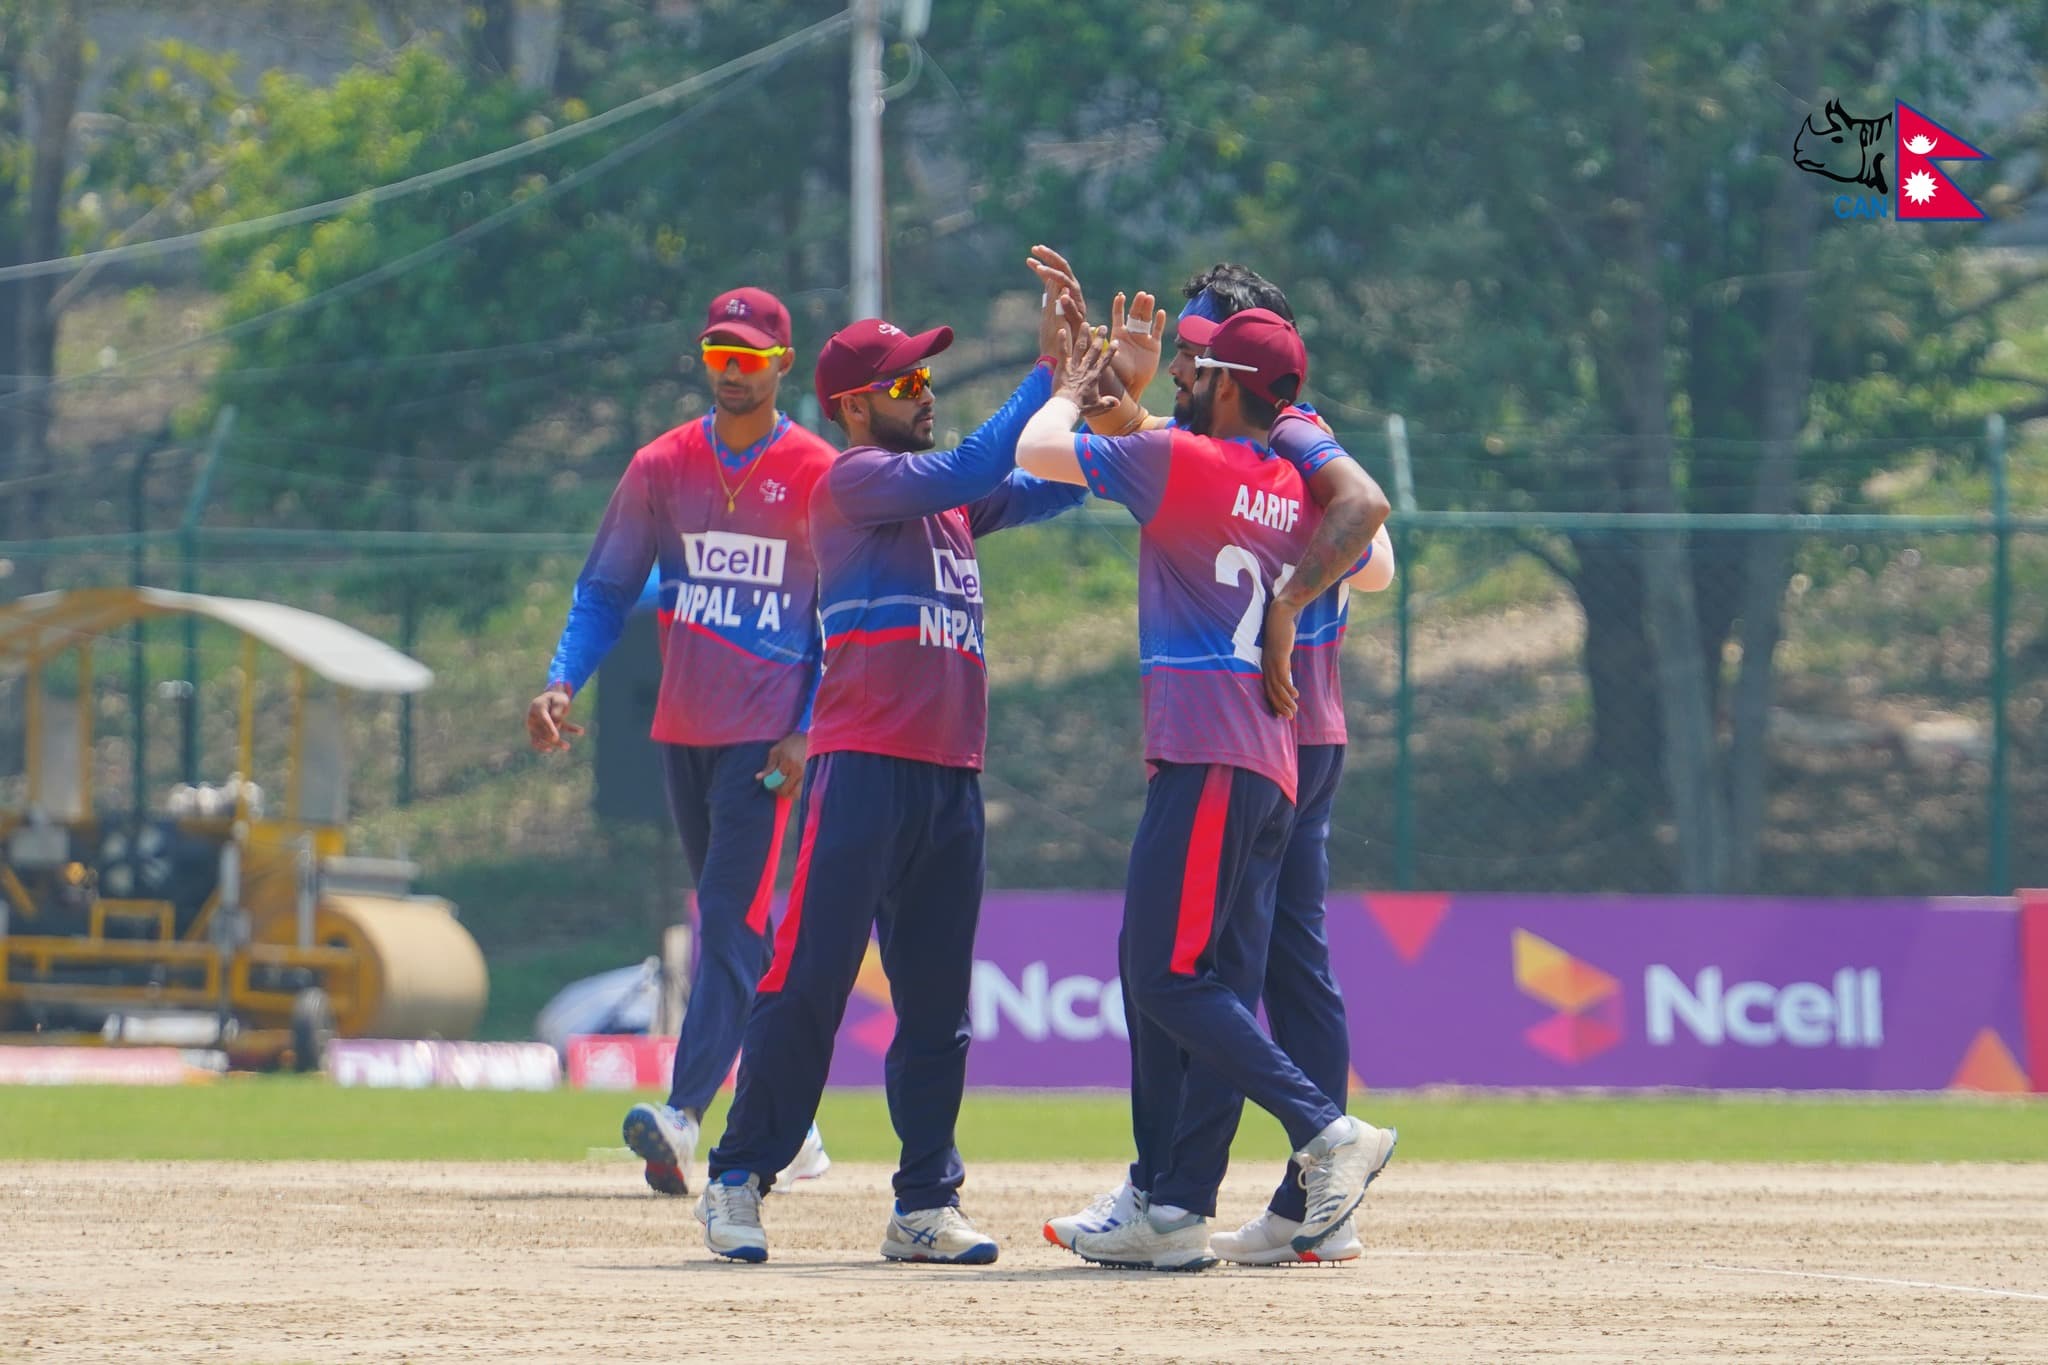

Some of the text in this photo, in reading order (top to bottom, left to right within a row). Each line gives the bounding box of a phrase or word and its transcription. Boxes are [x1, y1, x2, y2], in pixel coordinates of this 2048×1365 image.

[1231, 484, 1300, 533] AARIF
[673, 582, 742, 627] NPAL
[1215, 544, 1296, 674] 2
[919, 606, 985, 653] NEPA
[1644, 963, 1882, 1048] Ncell
